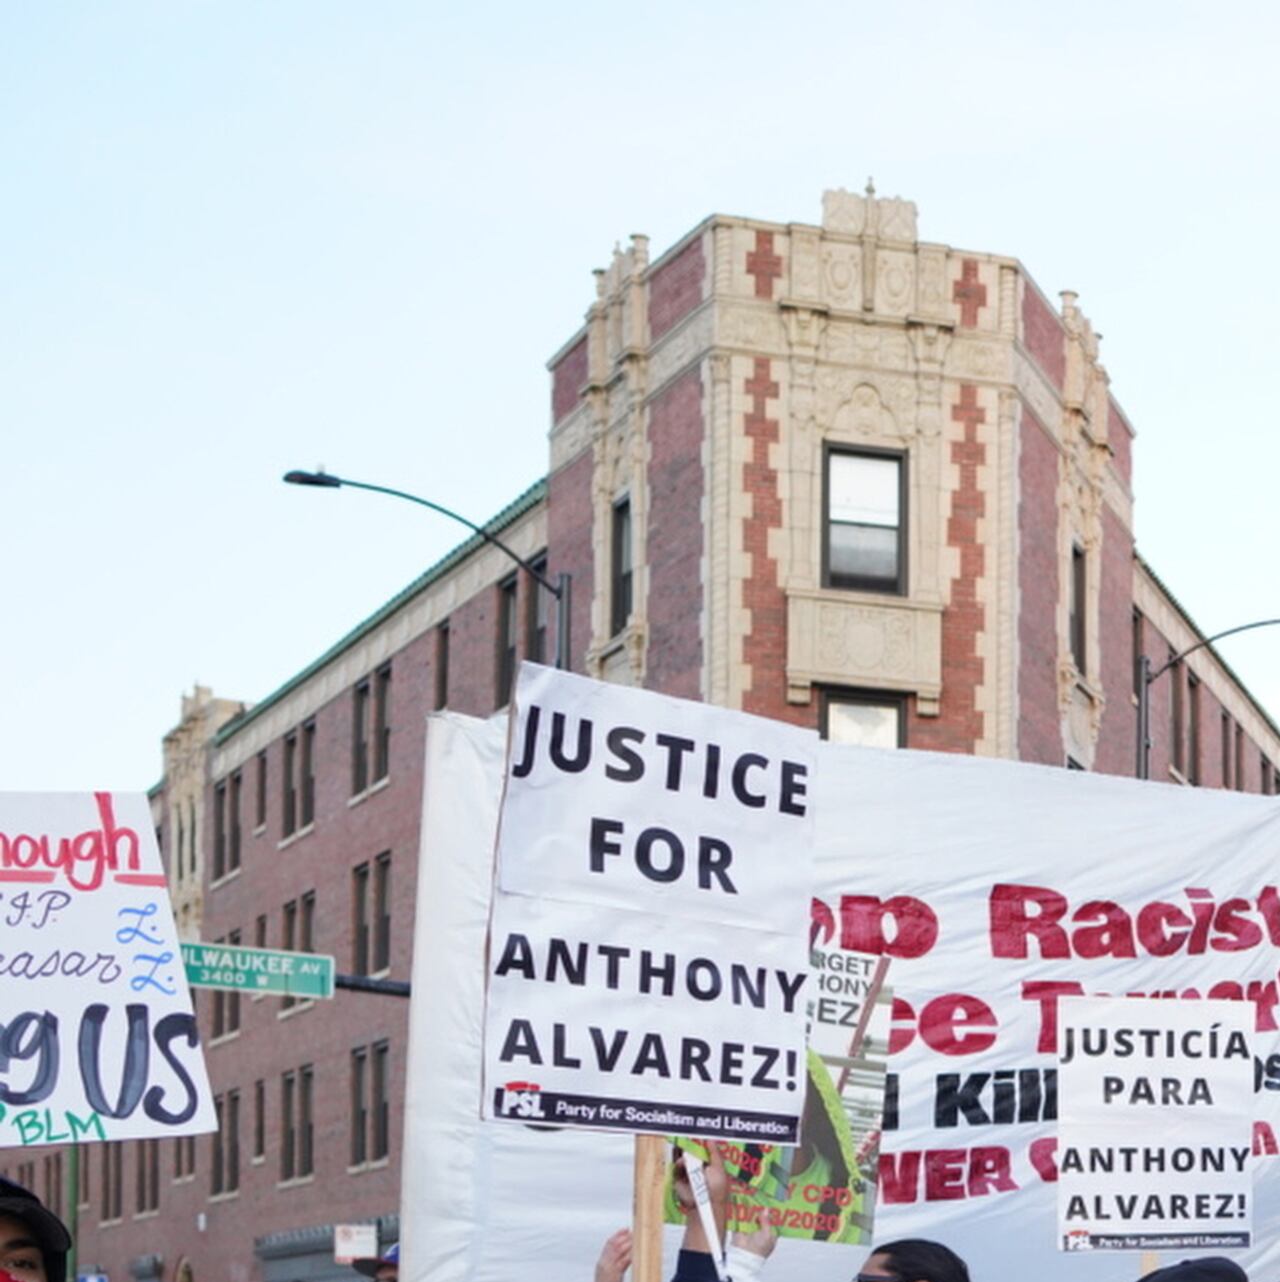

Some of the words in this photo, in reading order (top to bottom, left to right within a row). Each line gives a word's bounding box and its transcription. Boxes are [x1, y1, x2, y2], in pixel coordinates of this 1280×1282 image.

[511, 704, 808, 818] JUSTICE
[589, 817, 738, 894] FOR
[183, 948, 294, 975] ILWAUKEE
[300, 962, 321, 975] AV
[200, 970, 246, 984] 3400
[256, 974, 269, 987] W
[495, 932, 808, 1014] ANTHONY
[499, 1018, 798, 1092] ALVAREZ!
[1060, 1022, 1250, 1064] JUSTICÍA
[77, 1003, 199, 1126] US
[934, 1067, 1058, 1128] Kill
[1103, 1076, 1214, 1105] PARA
[12, 1110, 107, 1145] BLM
[556, 1101, 597, 1119] Party
[600, 1104, 620, 1121] for
[625, 1106, 694, 1127] Socialism
[696, 1114, 721, 1129] and
[878, 1145, 1021, 1205] VER
[1061, 1147, 1251, 1173] ANTHONY
[1065, 1193, 1246, 1221] ALVAREZ!
